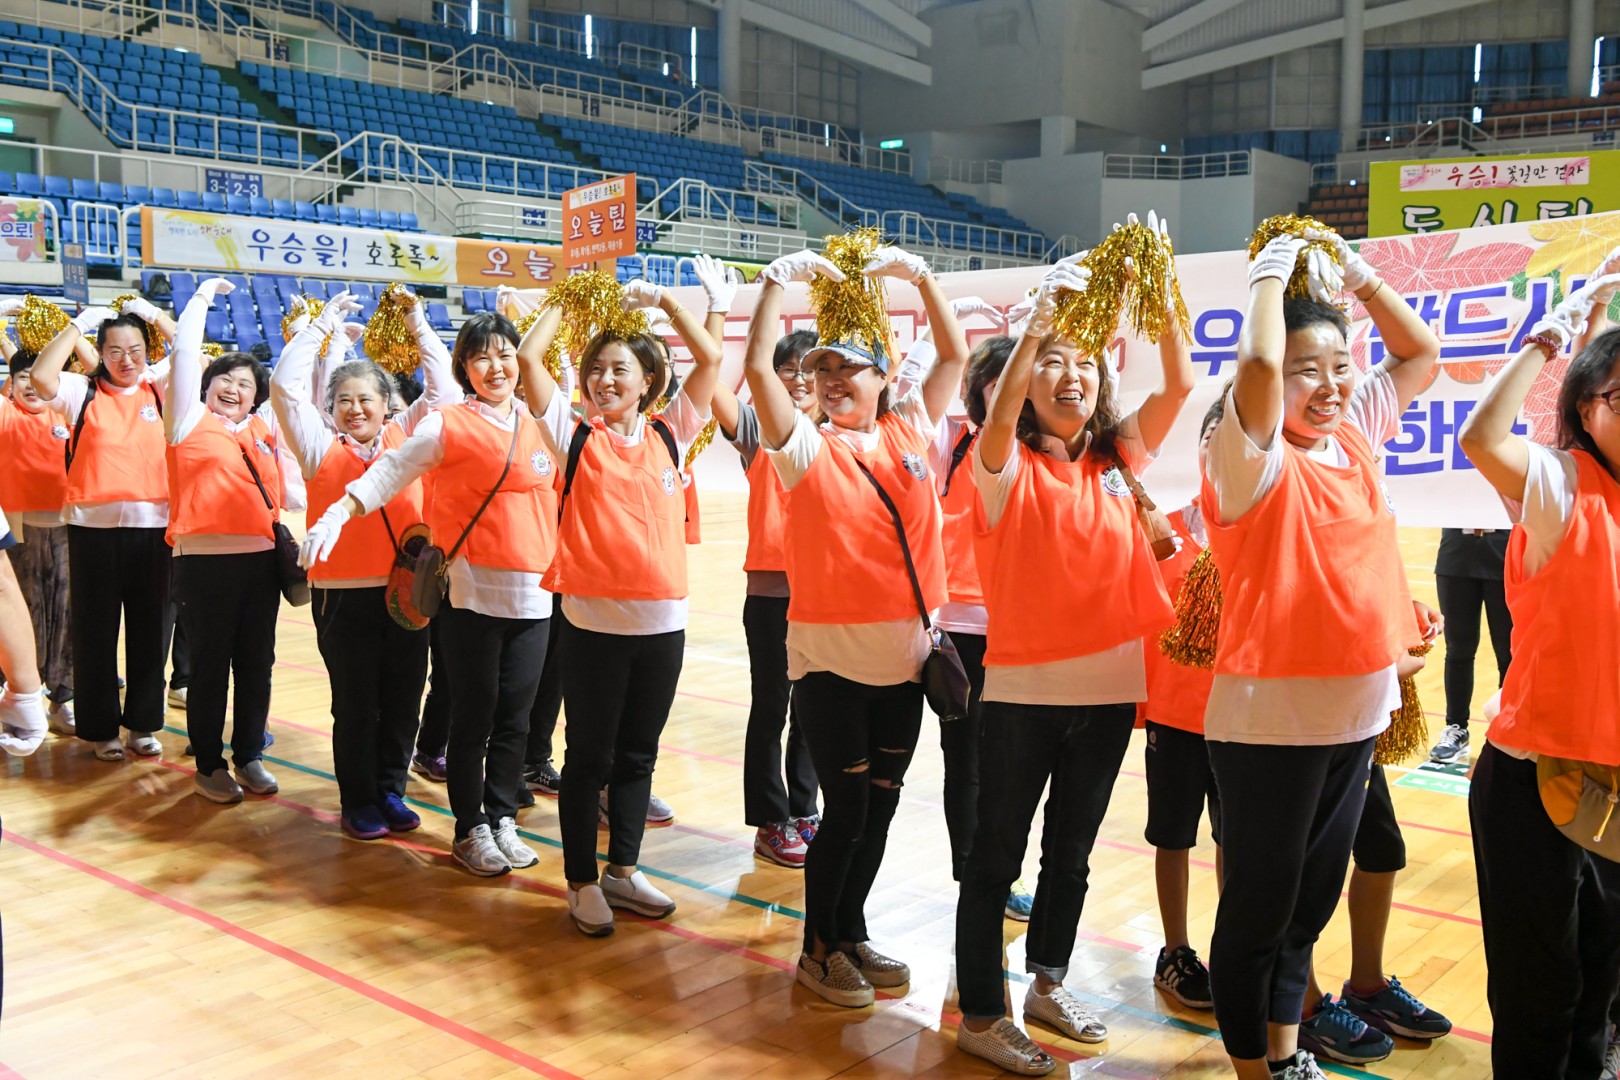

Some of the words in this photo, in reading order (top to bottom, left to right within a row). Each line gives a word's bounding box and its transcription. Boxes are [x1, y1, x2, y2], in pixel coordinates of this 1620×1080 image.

[1447, 164, 1498, 187] 우승!
[1507, 165, 1548, 184] 꽃길만
[210, 179, 228, 193] 3-
[234, 182, 259, 198] 2-3
[0, 221, 33, 238] 으로!
[569, 202, 627, 241] 오늘팀
[637, 228, 654, 241] 2-4
[246, 228, 348, 268] 우승을!
[365, 240, 439, 271] 호로록~
[481, 246, 590, 281] 오늘
